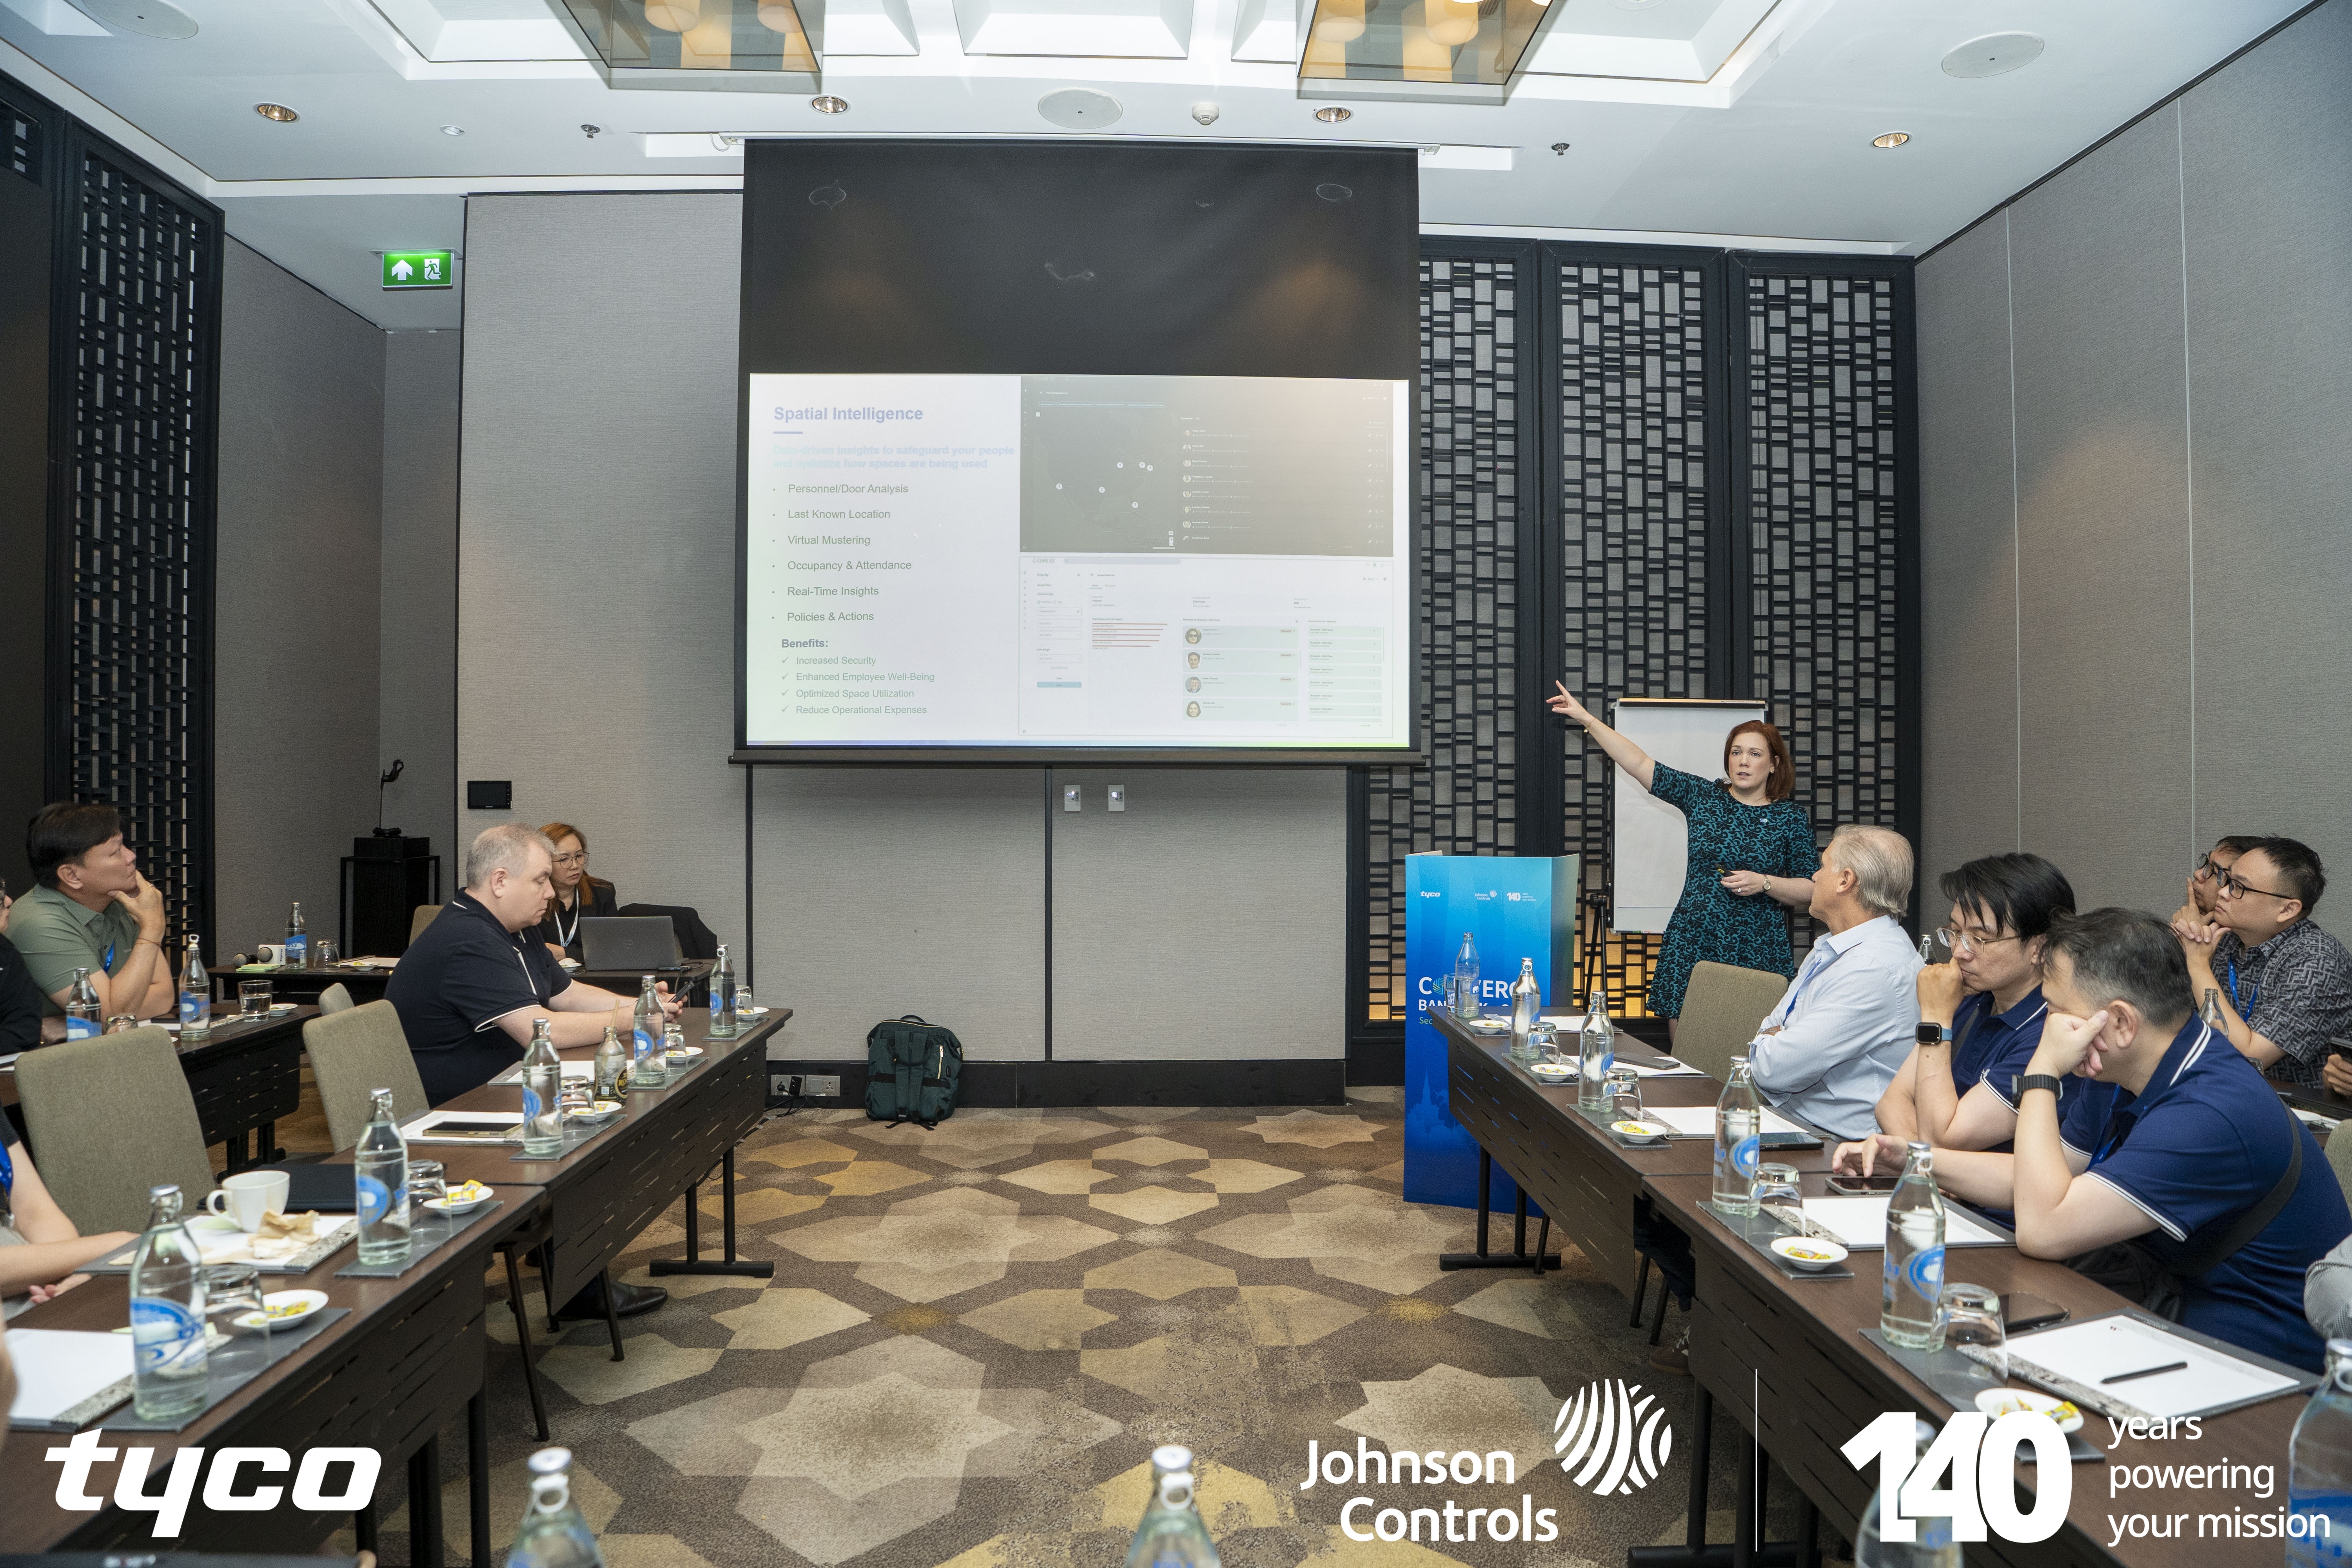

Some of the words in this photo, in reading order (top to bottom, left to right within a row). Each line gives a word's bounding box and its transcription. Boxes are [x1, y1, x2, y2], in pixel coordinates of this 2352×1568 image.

[774, 407, 827, 423] Spatial
[833, 407, 923, 423] Intelligence
[773, 446, 834, 454] Data-driven
[837, 446, 879, 456] insights
[896, 446, 949, 456] safeguard
[952, 448, 976, 456] your
[979, 446, 1014, 456] people
[773, 459, 792, 468] and
[796, 459, 840, 470] optimize
[844, 459, 866, 468] how
[869, 460, 906, 470] spaces
[929, 459, 958, 470] being
[962, 459, 987, 468] used
[789, 484, 865, 493] Personnel/Door
[867, 485, 908, 495] Analysis
[788, 510, 809, 518] Last
[812, 510, 845, 518] Known
[849, 510, 890, 518] Location
[788, 535, 818, 544] Virtual
[822, 535, 870, 546] Mustering
[788, 561, 843, 572] Occupancy
[846, 561, 853, 569] &
[856, 561, 911, 569] Attendance
[788, 587, 837, 595] Real-Time
[842, 586, 878, 597] Insights
[788, 612, 825, 621] Policies
[828, 612, 835, 621] &
[838, 612, 874, 621] Actions
[782, 639, 828, 648] Benefits:
[842, 657, 876, 666] Security
[843, 673, 885, 682] Employee
[888, 673, 934, 682] Well-Being
[796, 690, 839, 699] Optimized
[842, 690, 869, 699] Space
[832, 706, 881, 716] Operational
[885, 706, 927, 715] Expenses
[1506, 892, 1521, 901] 140
